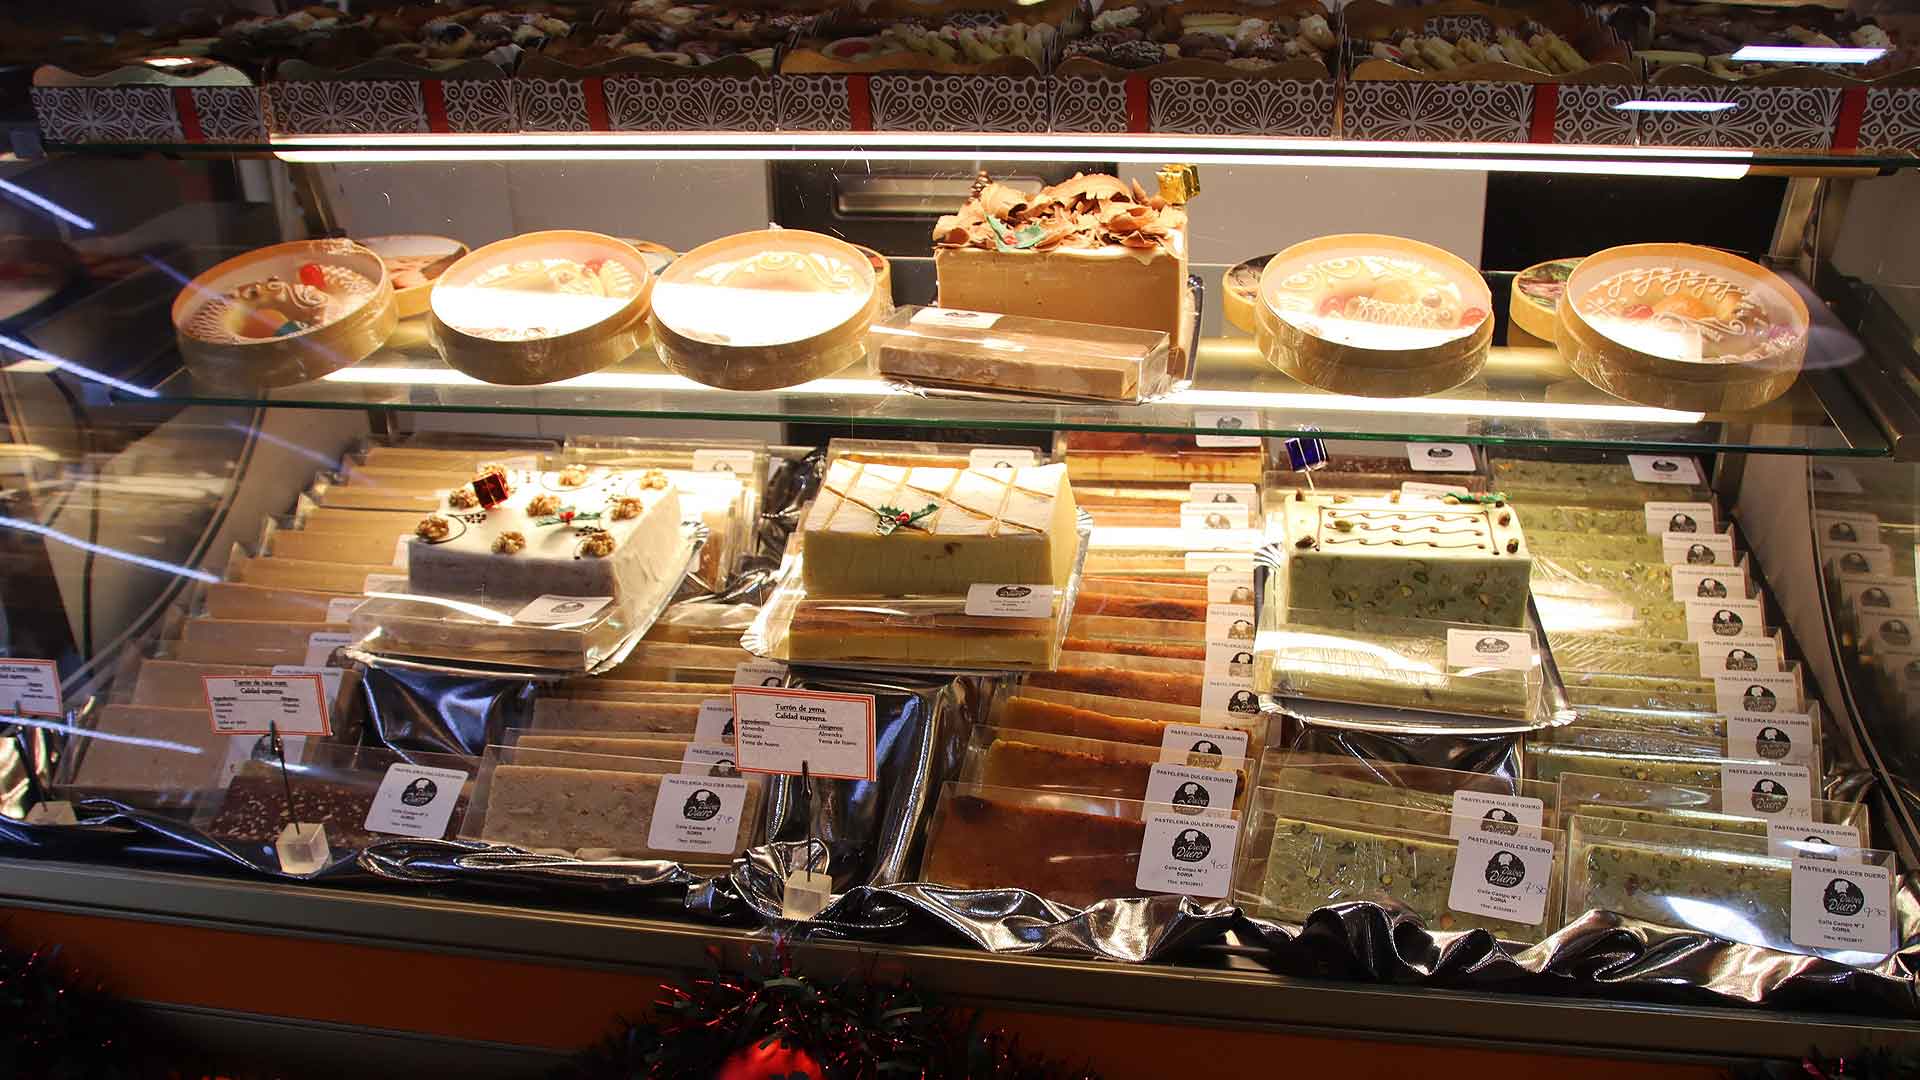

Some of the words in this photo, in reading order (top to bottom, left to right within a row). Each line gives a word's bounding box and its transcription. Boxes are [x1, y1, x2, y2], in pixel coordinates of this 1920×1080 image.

[775, 703, 797, 711] Turrón
[798, 704, 807, 712] de
[775, 712, 798, 720] Calidad
[1176, 846, 1203, 859] Duero
[1489, 870, 1517, 885] Duero
[1838, 868, 1863, 878] DULCES
[1864, 872, 1887, 880] DUERO
[1828, 898, 1857, 912] Duero
